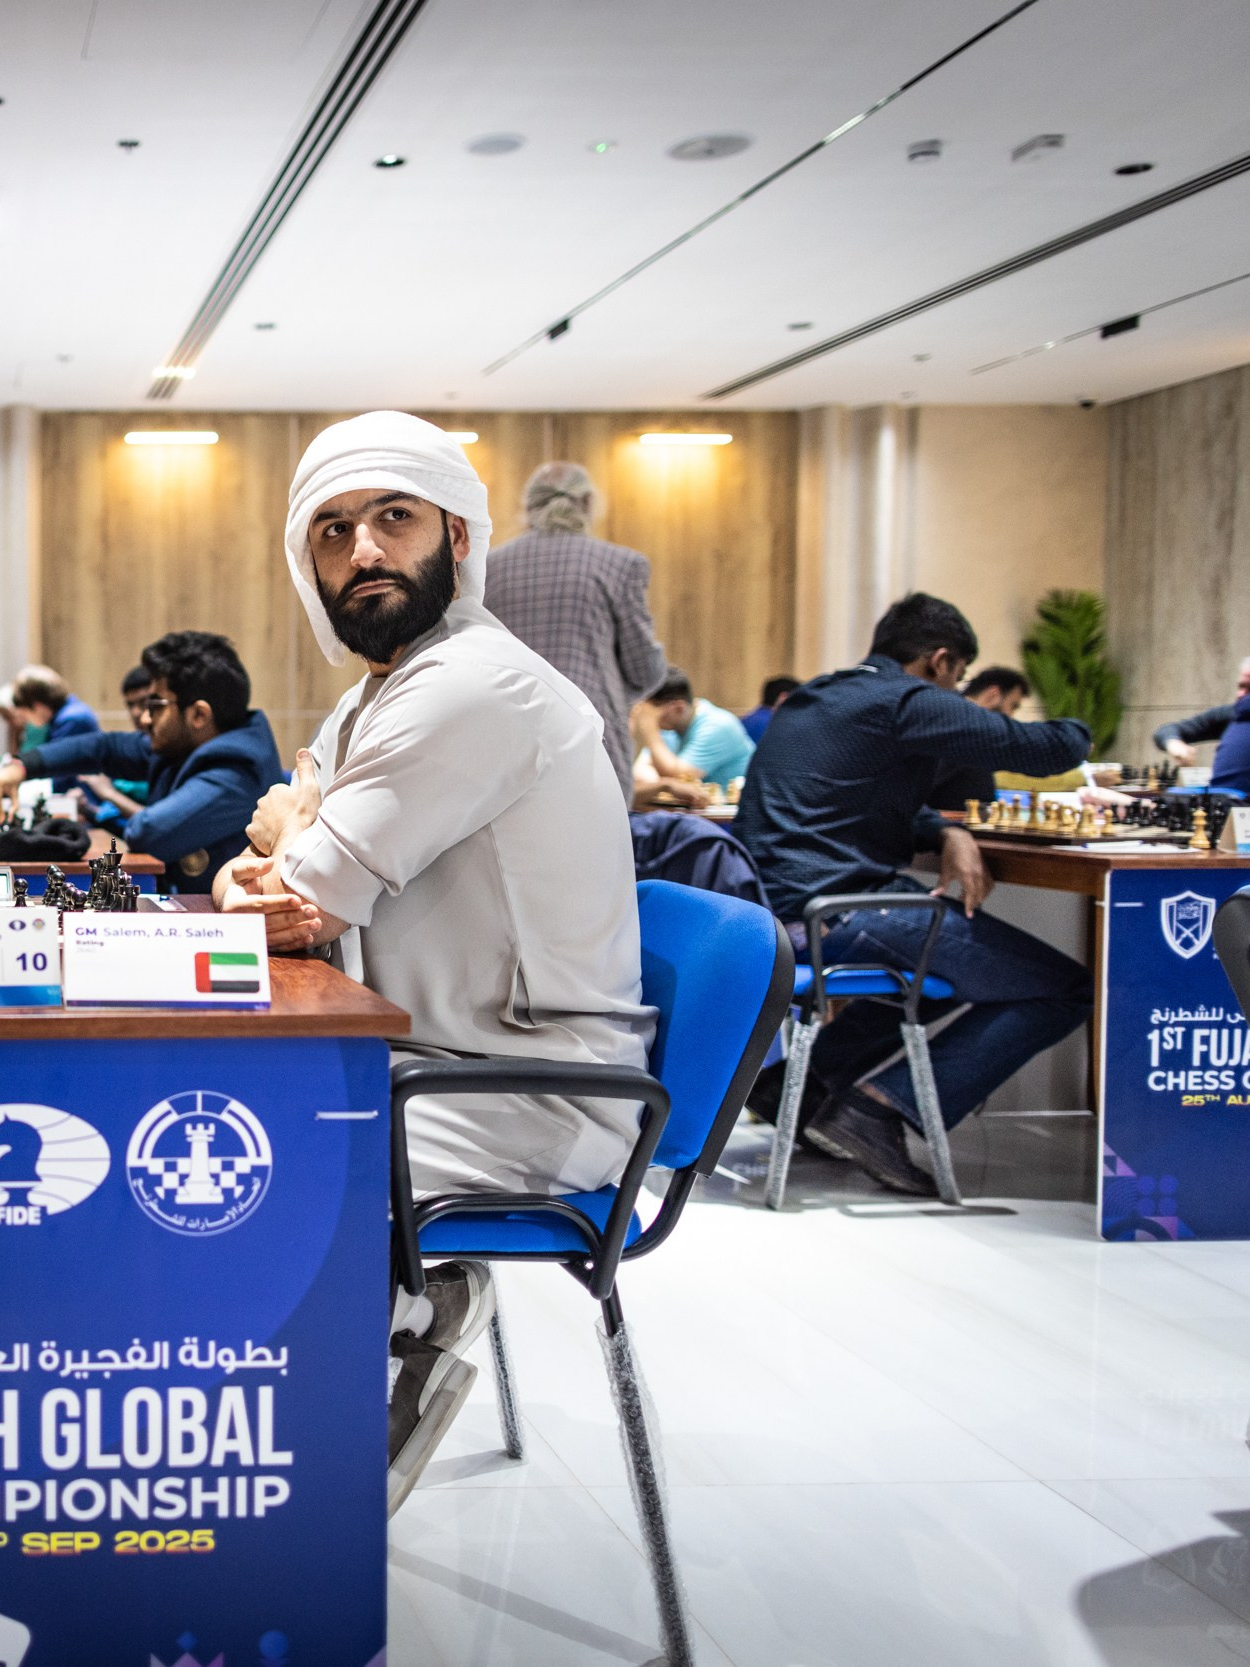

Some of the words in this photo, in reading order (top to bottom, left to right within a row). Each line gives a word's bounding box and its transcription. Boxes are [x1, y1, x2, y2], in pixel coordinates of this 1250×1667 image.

[75, 927, 97, 936] GM
[103, 927, 150, 939] Salem,
[154, 928, 181, 937] A.R.
[185, 928, 224, 938] Saleh
[16, 952, 48, 971] 10
[1151, 1004, 1224, 1025] للشطرنج
[1147, 1027, 1186, 1067] 1ST
[1147, 1069, 1236, 1091] CHESS
[37, 1337, 170, 1380] الفجيرة
[177, 1336, 289, 1377] بطولة
[40, 1385, 294, 1471] GLOBAL
[21, 1531, 101, 1557] SEP
[114, 1528, 216, 1554] 2025
